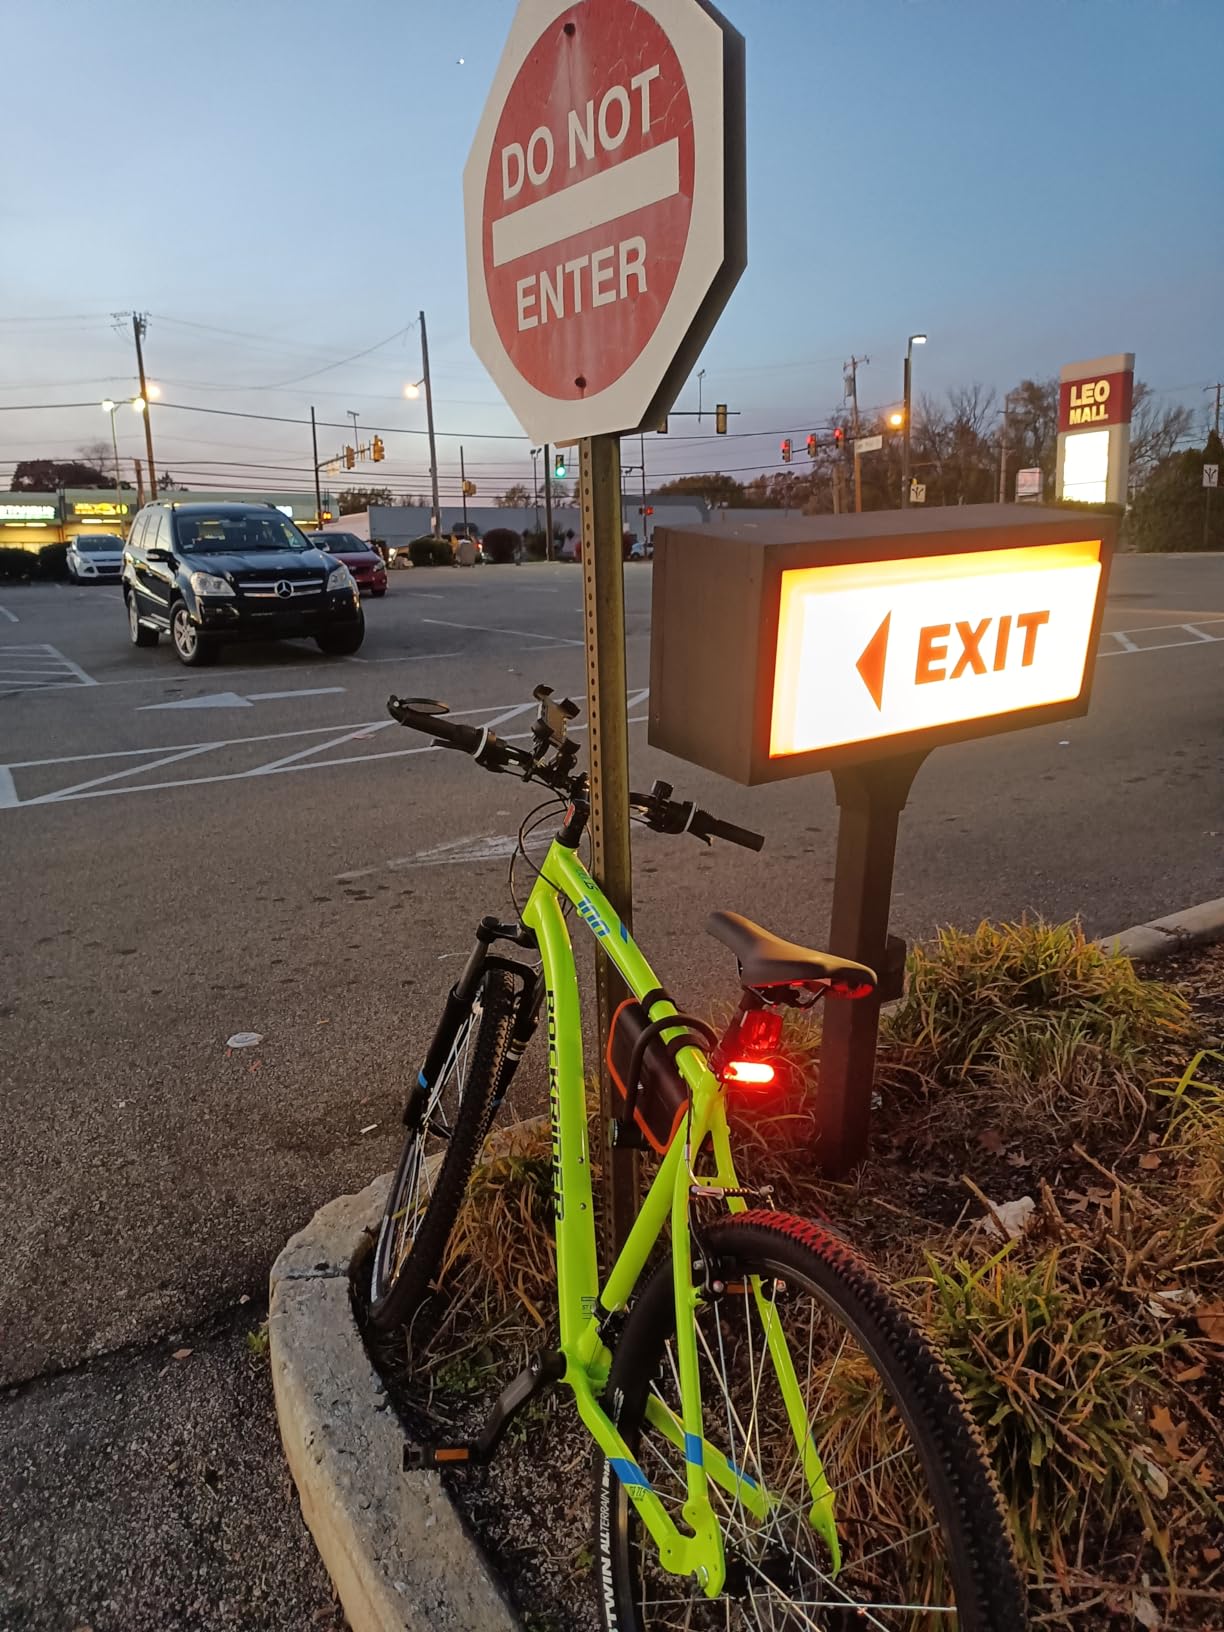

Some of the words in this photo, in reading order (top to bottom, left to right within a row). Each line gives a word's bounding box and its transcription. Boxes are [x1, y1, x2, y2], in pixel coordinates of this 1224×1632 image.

[501, 126, 554, 201] DO
[567, 64, 660, 169] NOT
[516, 235, 648, 332] ENTER
[1069, 404, 1109, 425] MALL
[1070, 380, 1110, 407] LEO
[914, 610, 1050, 685] EXIT
